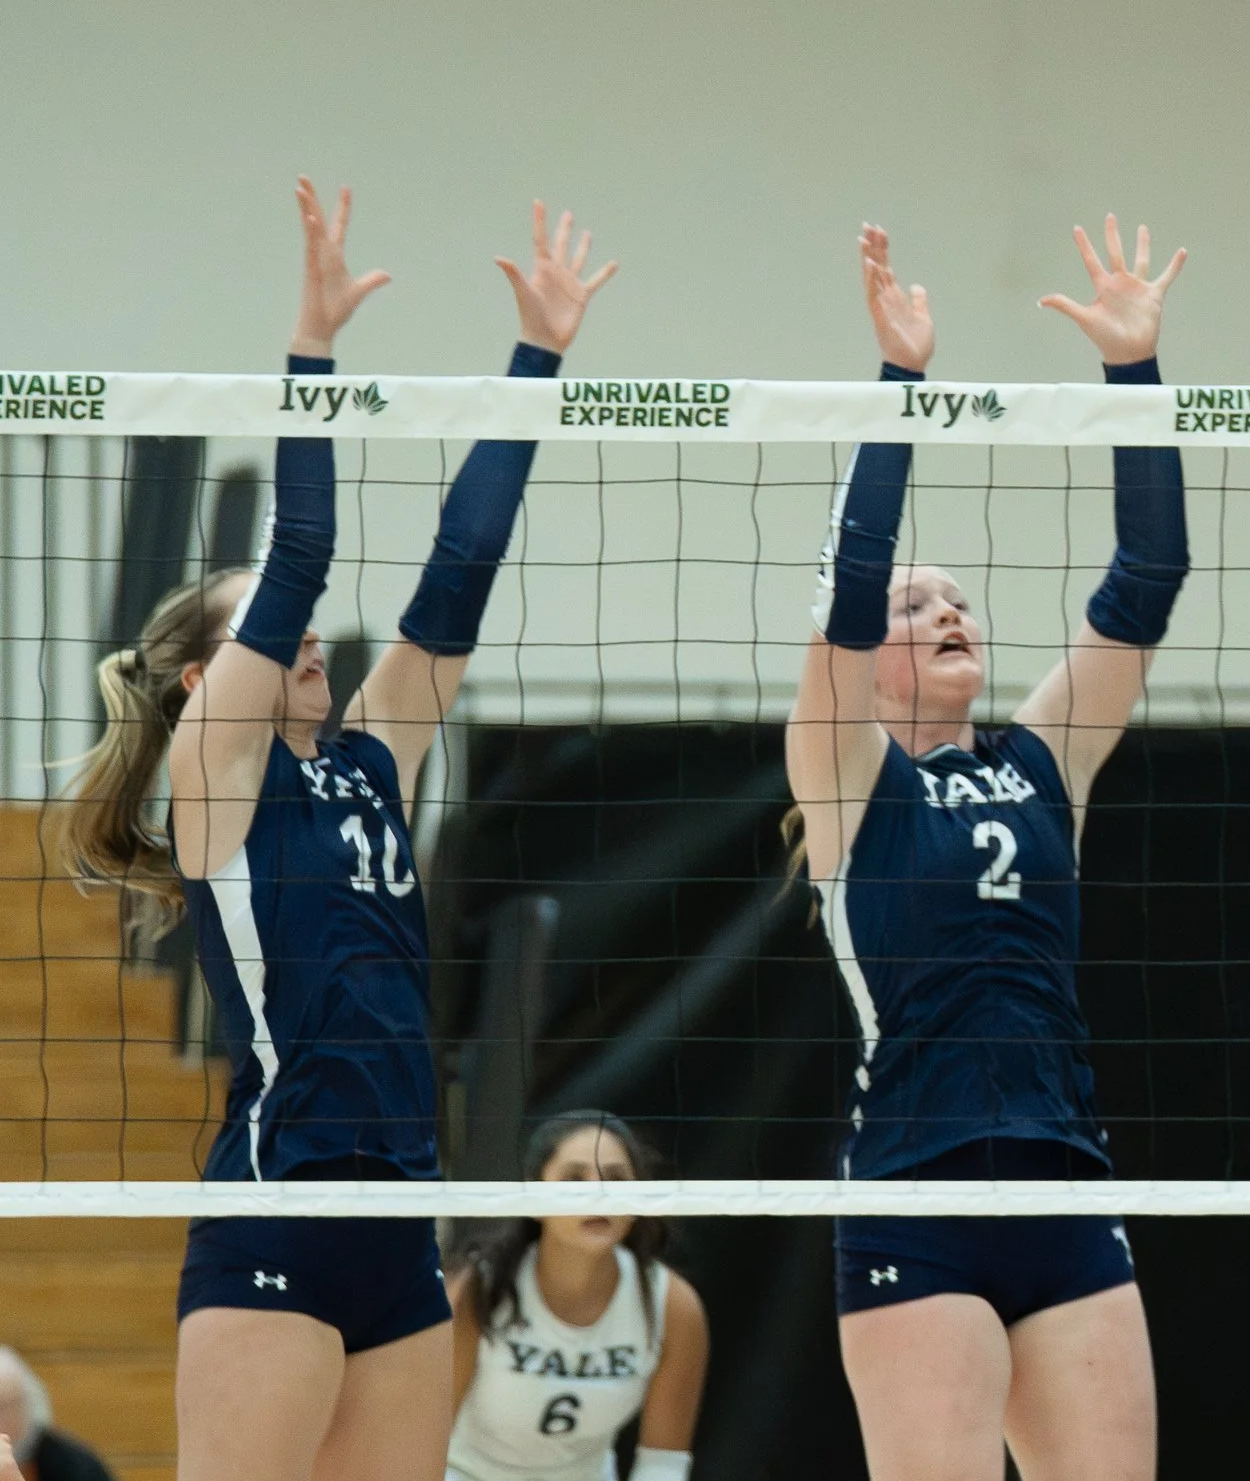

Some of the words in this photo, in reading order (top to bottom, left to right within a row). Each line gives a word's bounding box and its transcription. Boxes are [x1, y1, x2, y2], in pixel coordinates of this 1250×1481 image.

[0, 399, 105, 420] RIENCE
[280, 377, 349, 422] Ivy
[561, 382, 731, 405] UNRIVALED
[900, 384, 968, 429] Ivy
[560, 406, 730, 428] EXPERIENCE
[972, 820, 1022, 900] 2
[508, 1339, 636, 1379] YALE
[540, 1392, 581, 1435] 6
